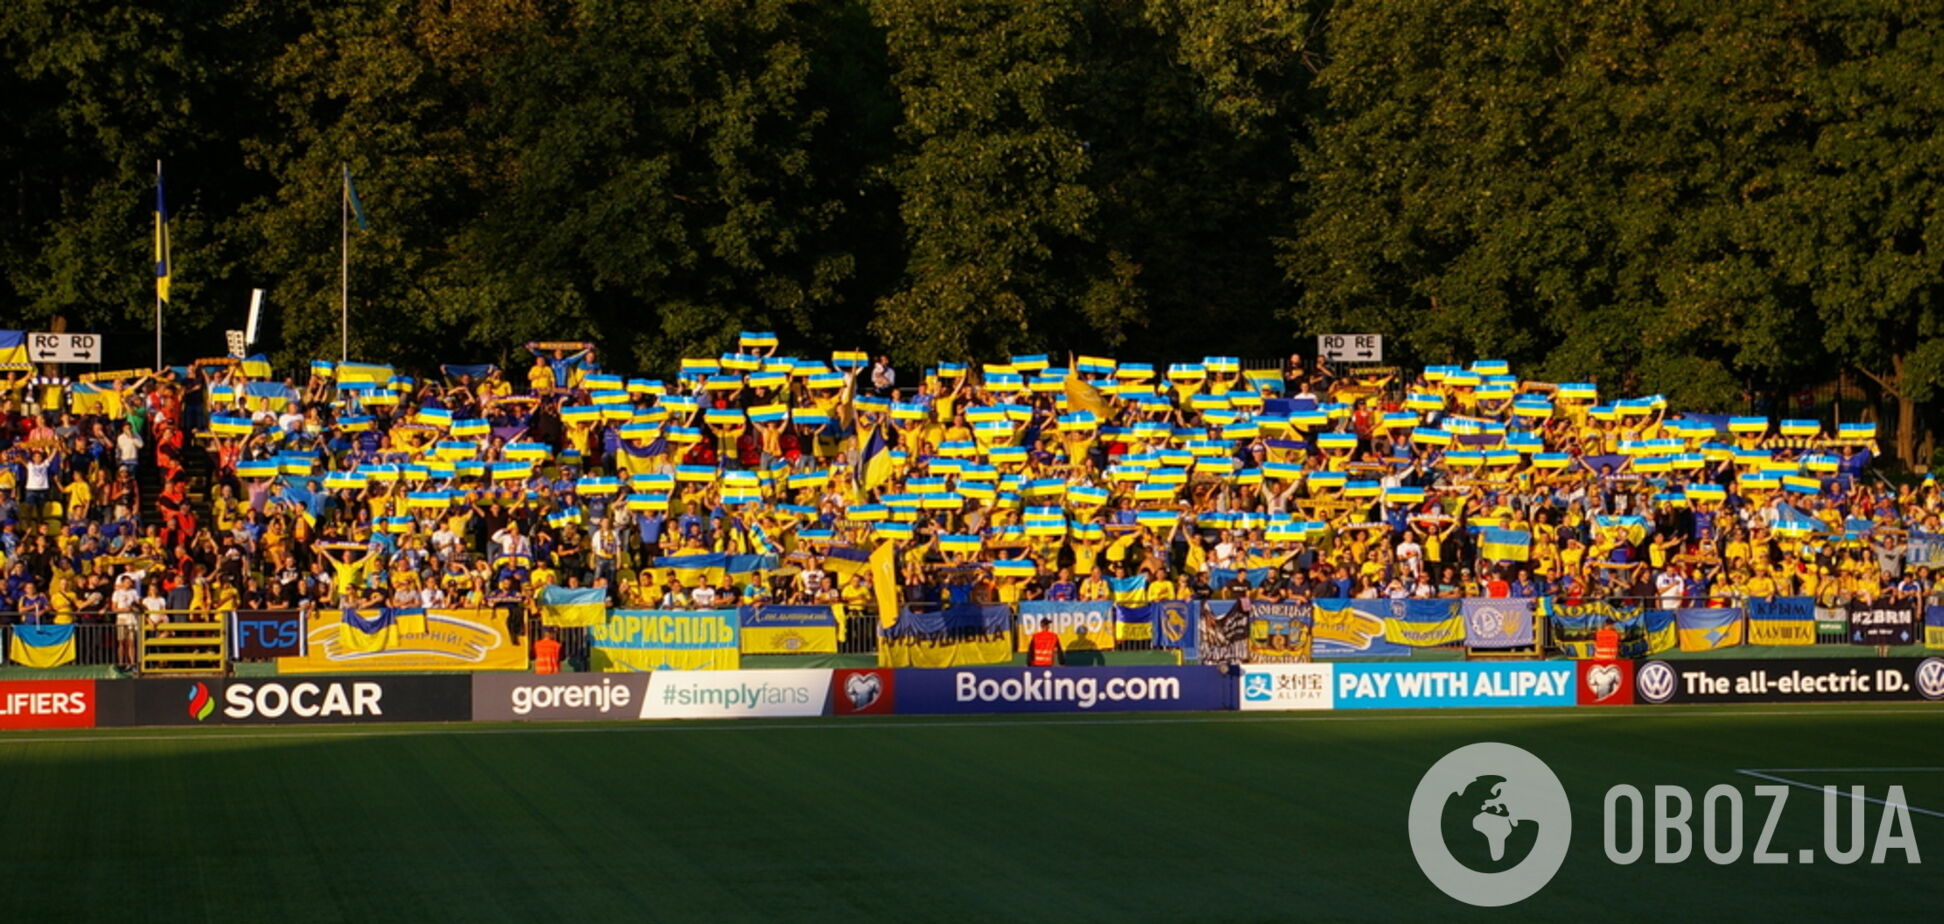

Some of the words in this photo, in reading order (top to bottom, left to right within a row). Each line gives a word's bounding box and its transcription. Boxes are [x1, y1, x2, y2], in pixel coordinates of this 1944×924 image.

[35, 335, 60, 348] RC
[70, 335, 95, 348] RD
[1324, 335, 1345, 348] RD
[1355, 335, 1376, 348] RE
[1757, 603, 1807, 616] КРЫМ
[238, 619, 299, 648] FCS
[592, 614, 734, 644] БОРИСПІЛЬ
[1755, 626, 1810, 640] АЛУШТА
[955, 671, 1180, 708] Booking.com
[1276, 673, 1323, 690] 支付宝
[1339, 672, 1393, 698] PAY
[1394, 672, 1469, 697] WITH
[1473, 670, 1571, 696] ALIPAY
[1682, 672, 1731, 694] The
[1735, 669, 1871, 693] all-electric
[1876, 669, 1911, 692] ID.
[223, 682, 383, 718] SOCAR
[511, 678, 631, 715] gorenje
[663, 682, 810, 709] #simplyfans
[1277, 691, 1322, 700] ALIPAY
